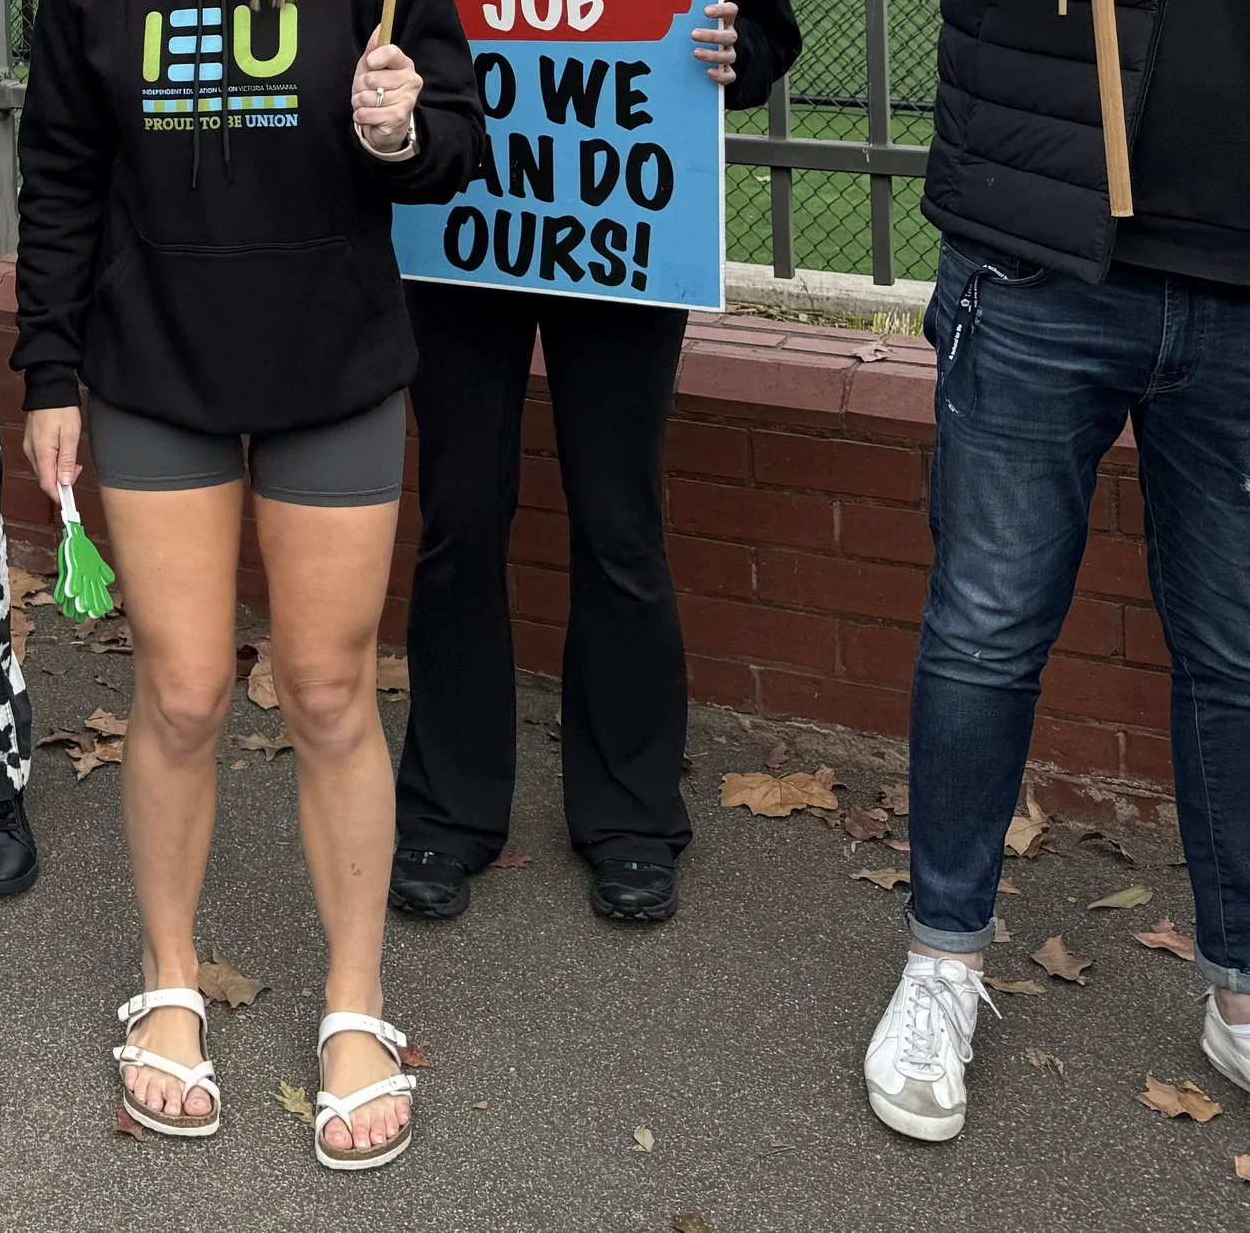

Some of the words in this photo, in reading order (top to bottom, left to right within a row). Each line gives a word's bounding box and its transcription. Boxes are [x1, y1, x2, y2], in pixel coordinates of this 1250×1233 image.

[142, 2, 298, 83] IEU
[183, 87, 217, 95] EDUATION
[199, 116, 221, 130] TO
[245, 113, 298, 128] UNION
[471, 52, 516, 121] O
[539, 54, 654, 132] WE
[460, 133, 555, 202] AN
[580, 139, 674, 212] DO
[443, 205, 652, 292] OURS!
